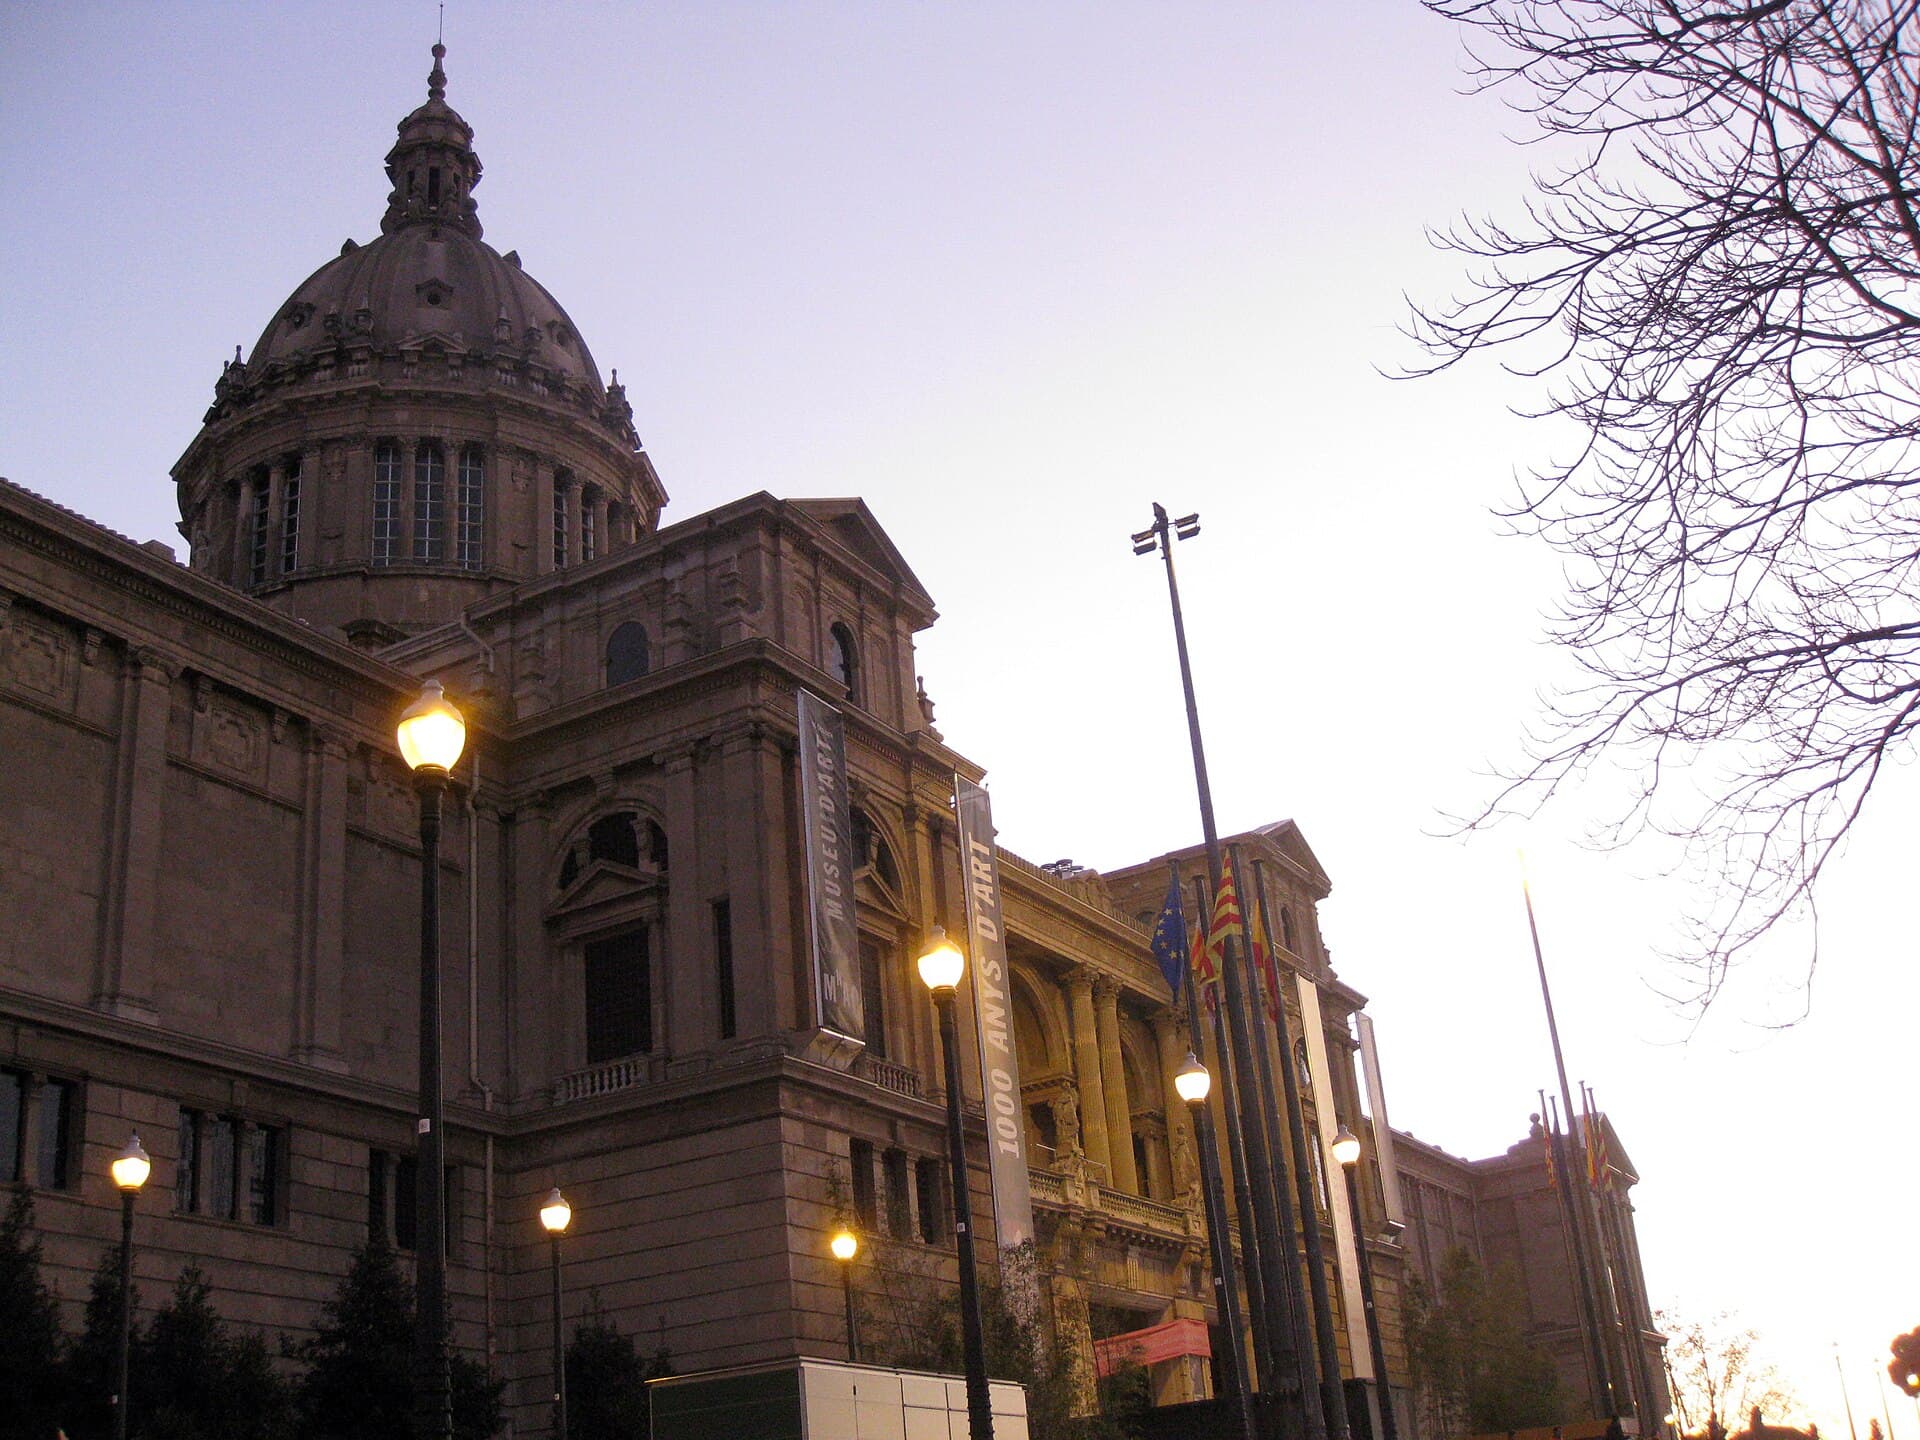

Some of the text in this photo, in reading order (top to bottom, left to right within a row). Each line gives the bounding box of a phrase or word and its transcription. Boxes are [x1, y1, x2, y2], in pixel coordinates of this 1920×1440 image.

[816, 727, 844, 921] MUSEU D'ART
[967, 832, 1019, 1159] 1000 ANYS D'ART
